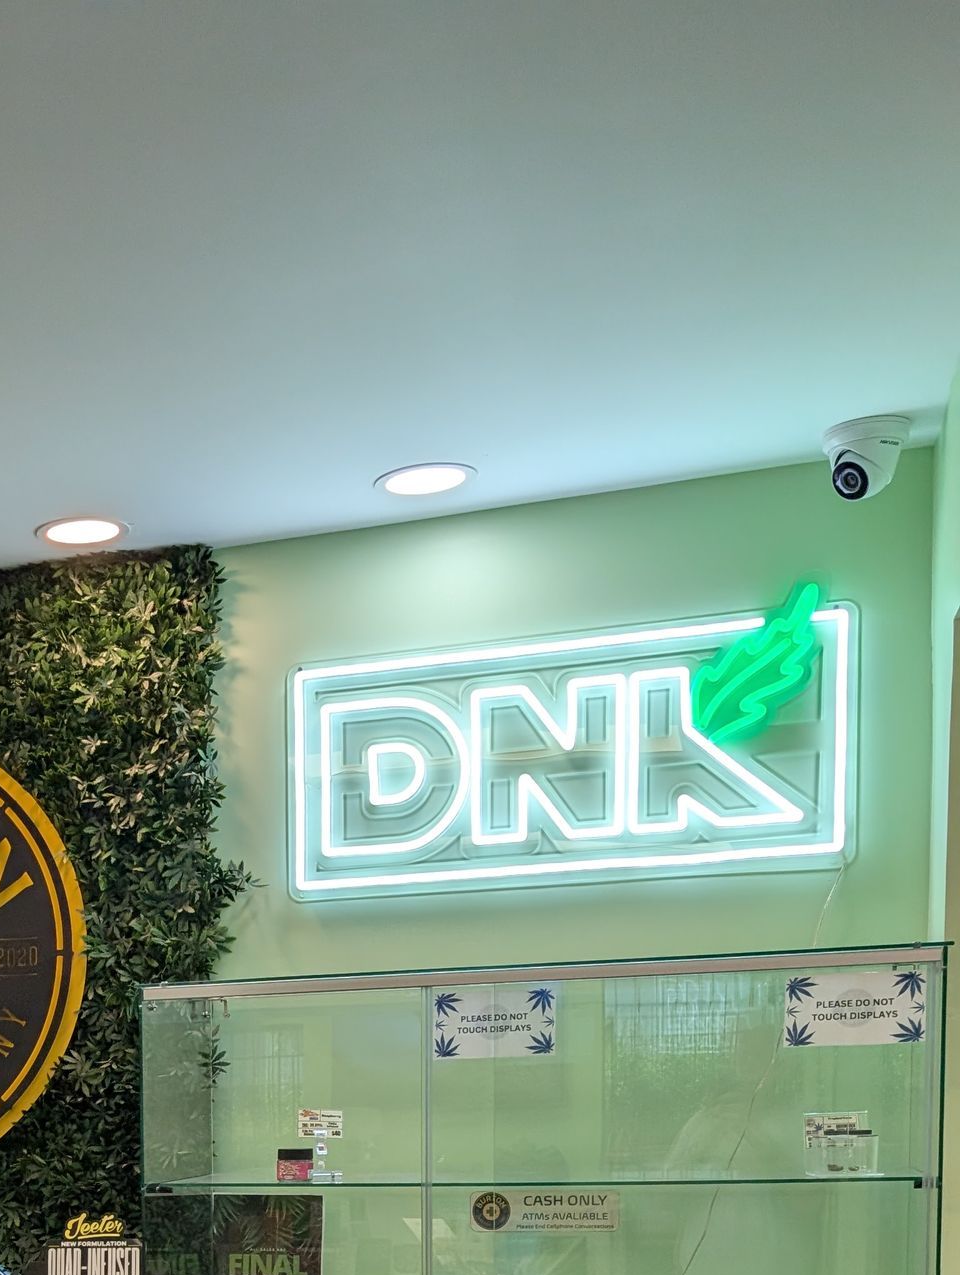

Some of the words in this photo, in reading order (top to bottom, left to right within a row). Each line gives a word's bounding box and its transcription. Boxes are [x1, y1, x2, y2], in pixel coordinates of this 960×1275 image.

[320, 666, 804, 857] DNK
[816, 999, 853, 1009] PLEASE
[855, 998, 870, 1008] DO
[873, 997, 895, 1006] NOT
[460, 1014, 492, 1023] PLEASE
[494, 1013, 507, 1022] DO
[510, 1012, 528, 1021] NOT
[812, 1011, 847, 1022] TOUCH
[850, 1010, 898, 1020] DISPLAYS
[457, 1025, 487, 1034] TOUCH
[490, 1024, 531, 1033] DISPLAYS
[523, 1195, 563, 1207] CASH
[567, 1194, 607, 1206] ONLY
[522, 1212, 550, 1221] ATMs
[552, 1211, 608, 1221] AVALIABLE
[64, 1212, 124, 1240] Jeeter
